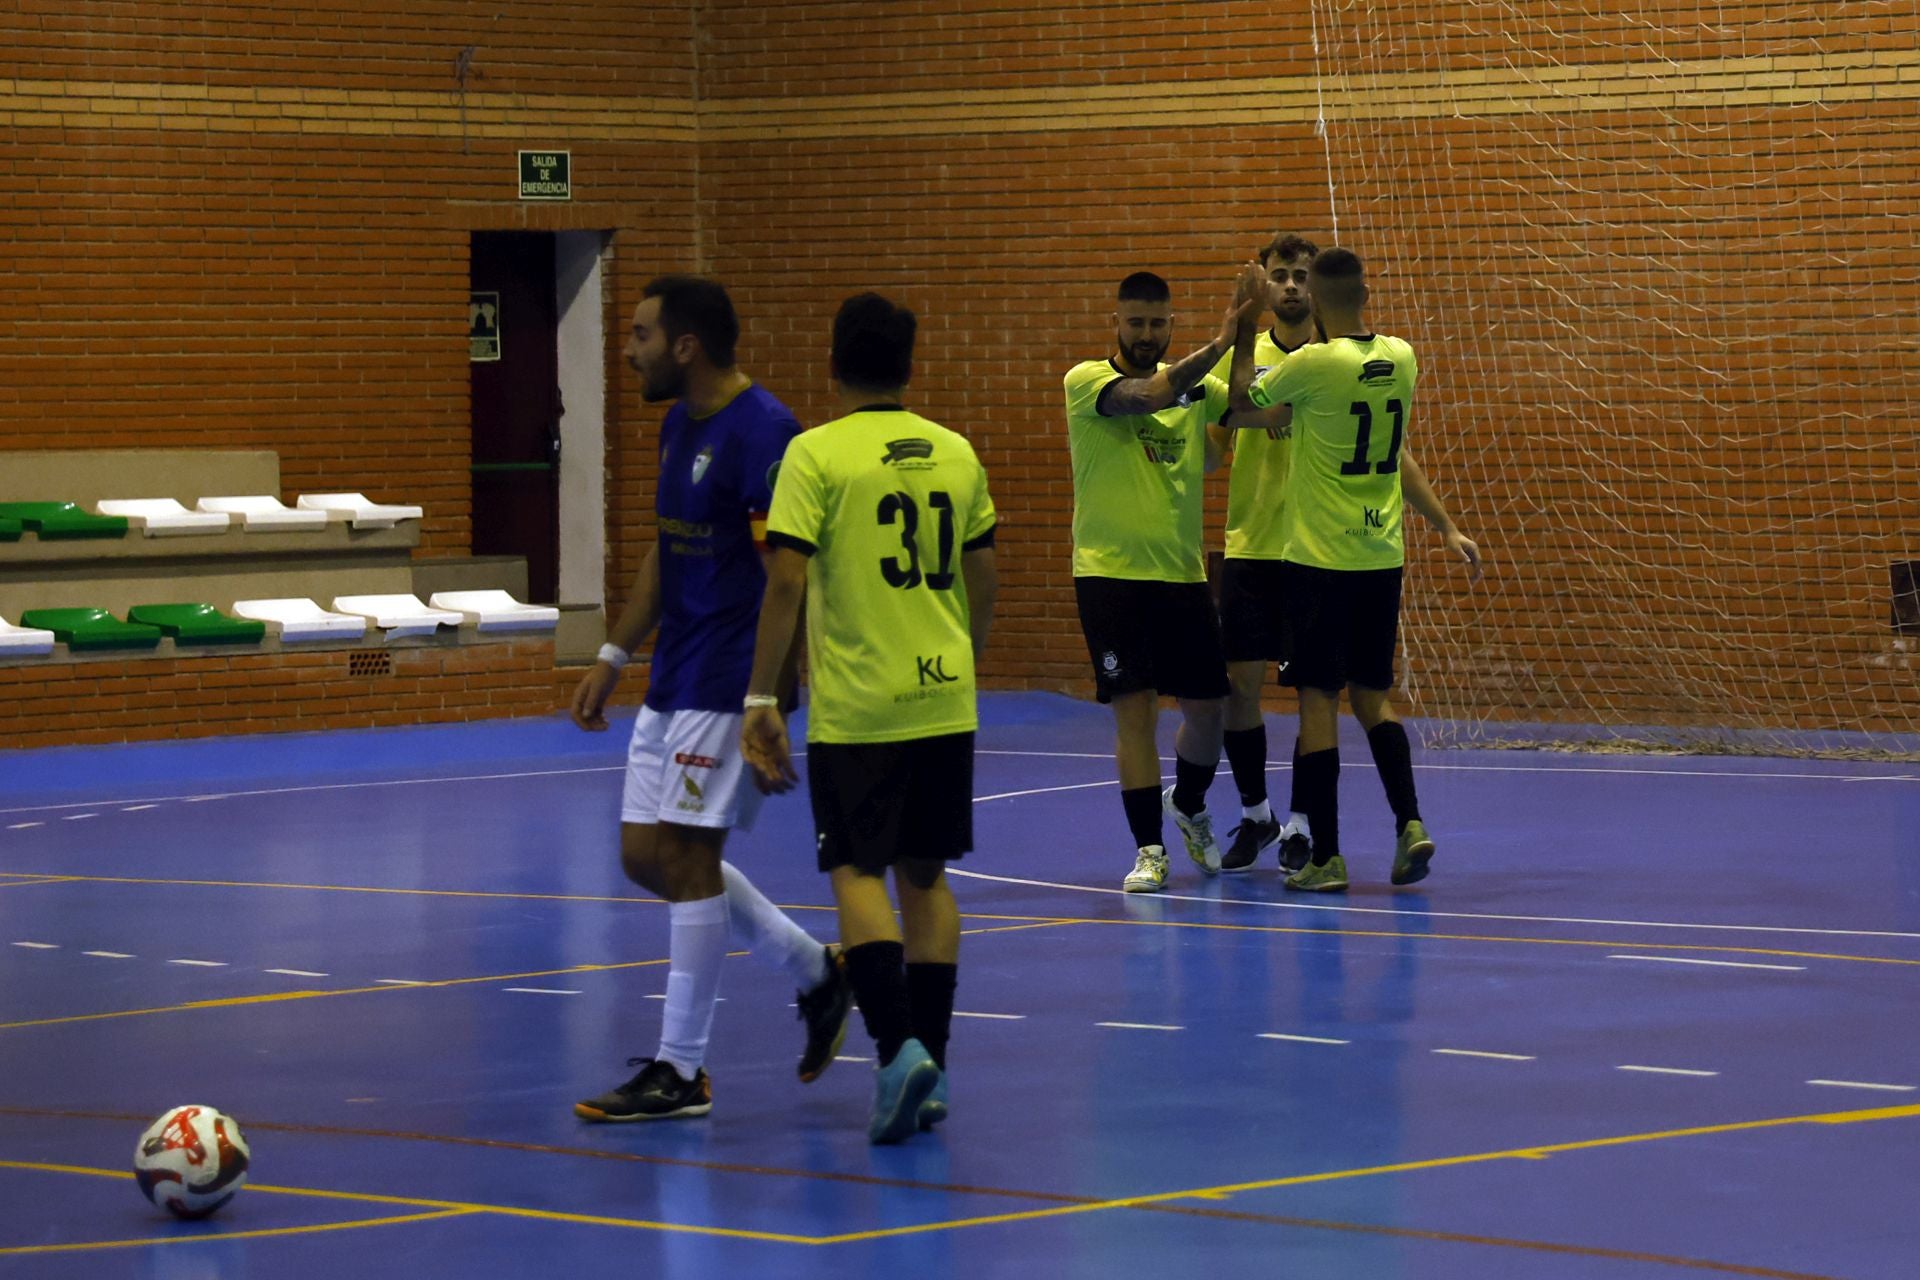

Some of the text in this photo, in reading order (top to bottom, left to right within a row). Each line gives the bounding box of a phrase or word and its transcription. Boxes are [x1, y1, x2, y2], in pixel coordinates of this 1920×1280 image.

[532, 155, 557, 168] SALIDA
[540, 169, 550, 181] DE
[522, 182, 568, 194] EMERGENCIA
[1340, 398, 1403, 475] 11
[1363, 505, 1384, 528] KL
[877, 490, 955, 590] 31
[916, 655, 959, 686] KL
